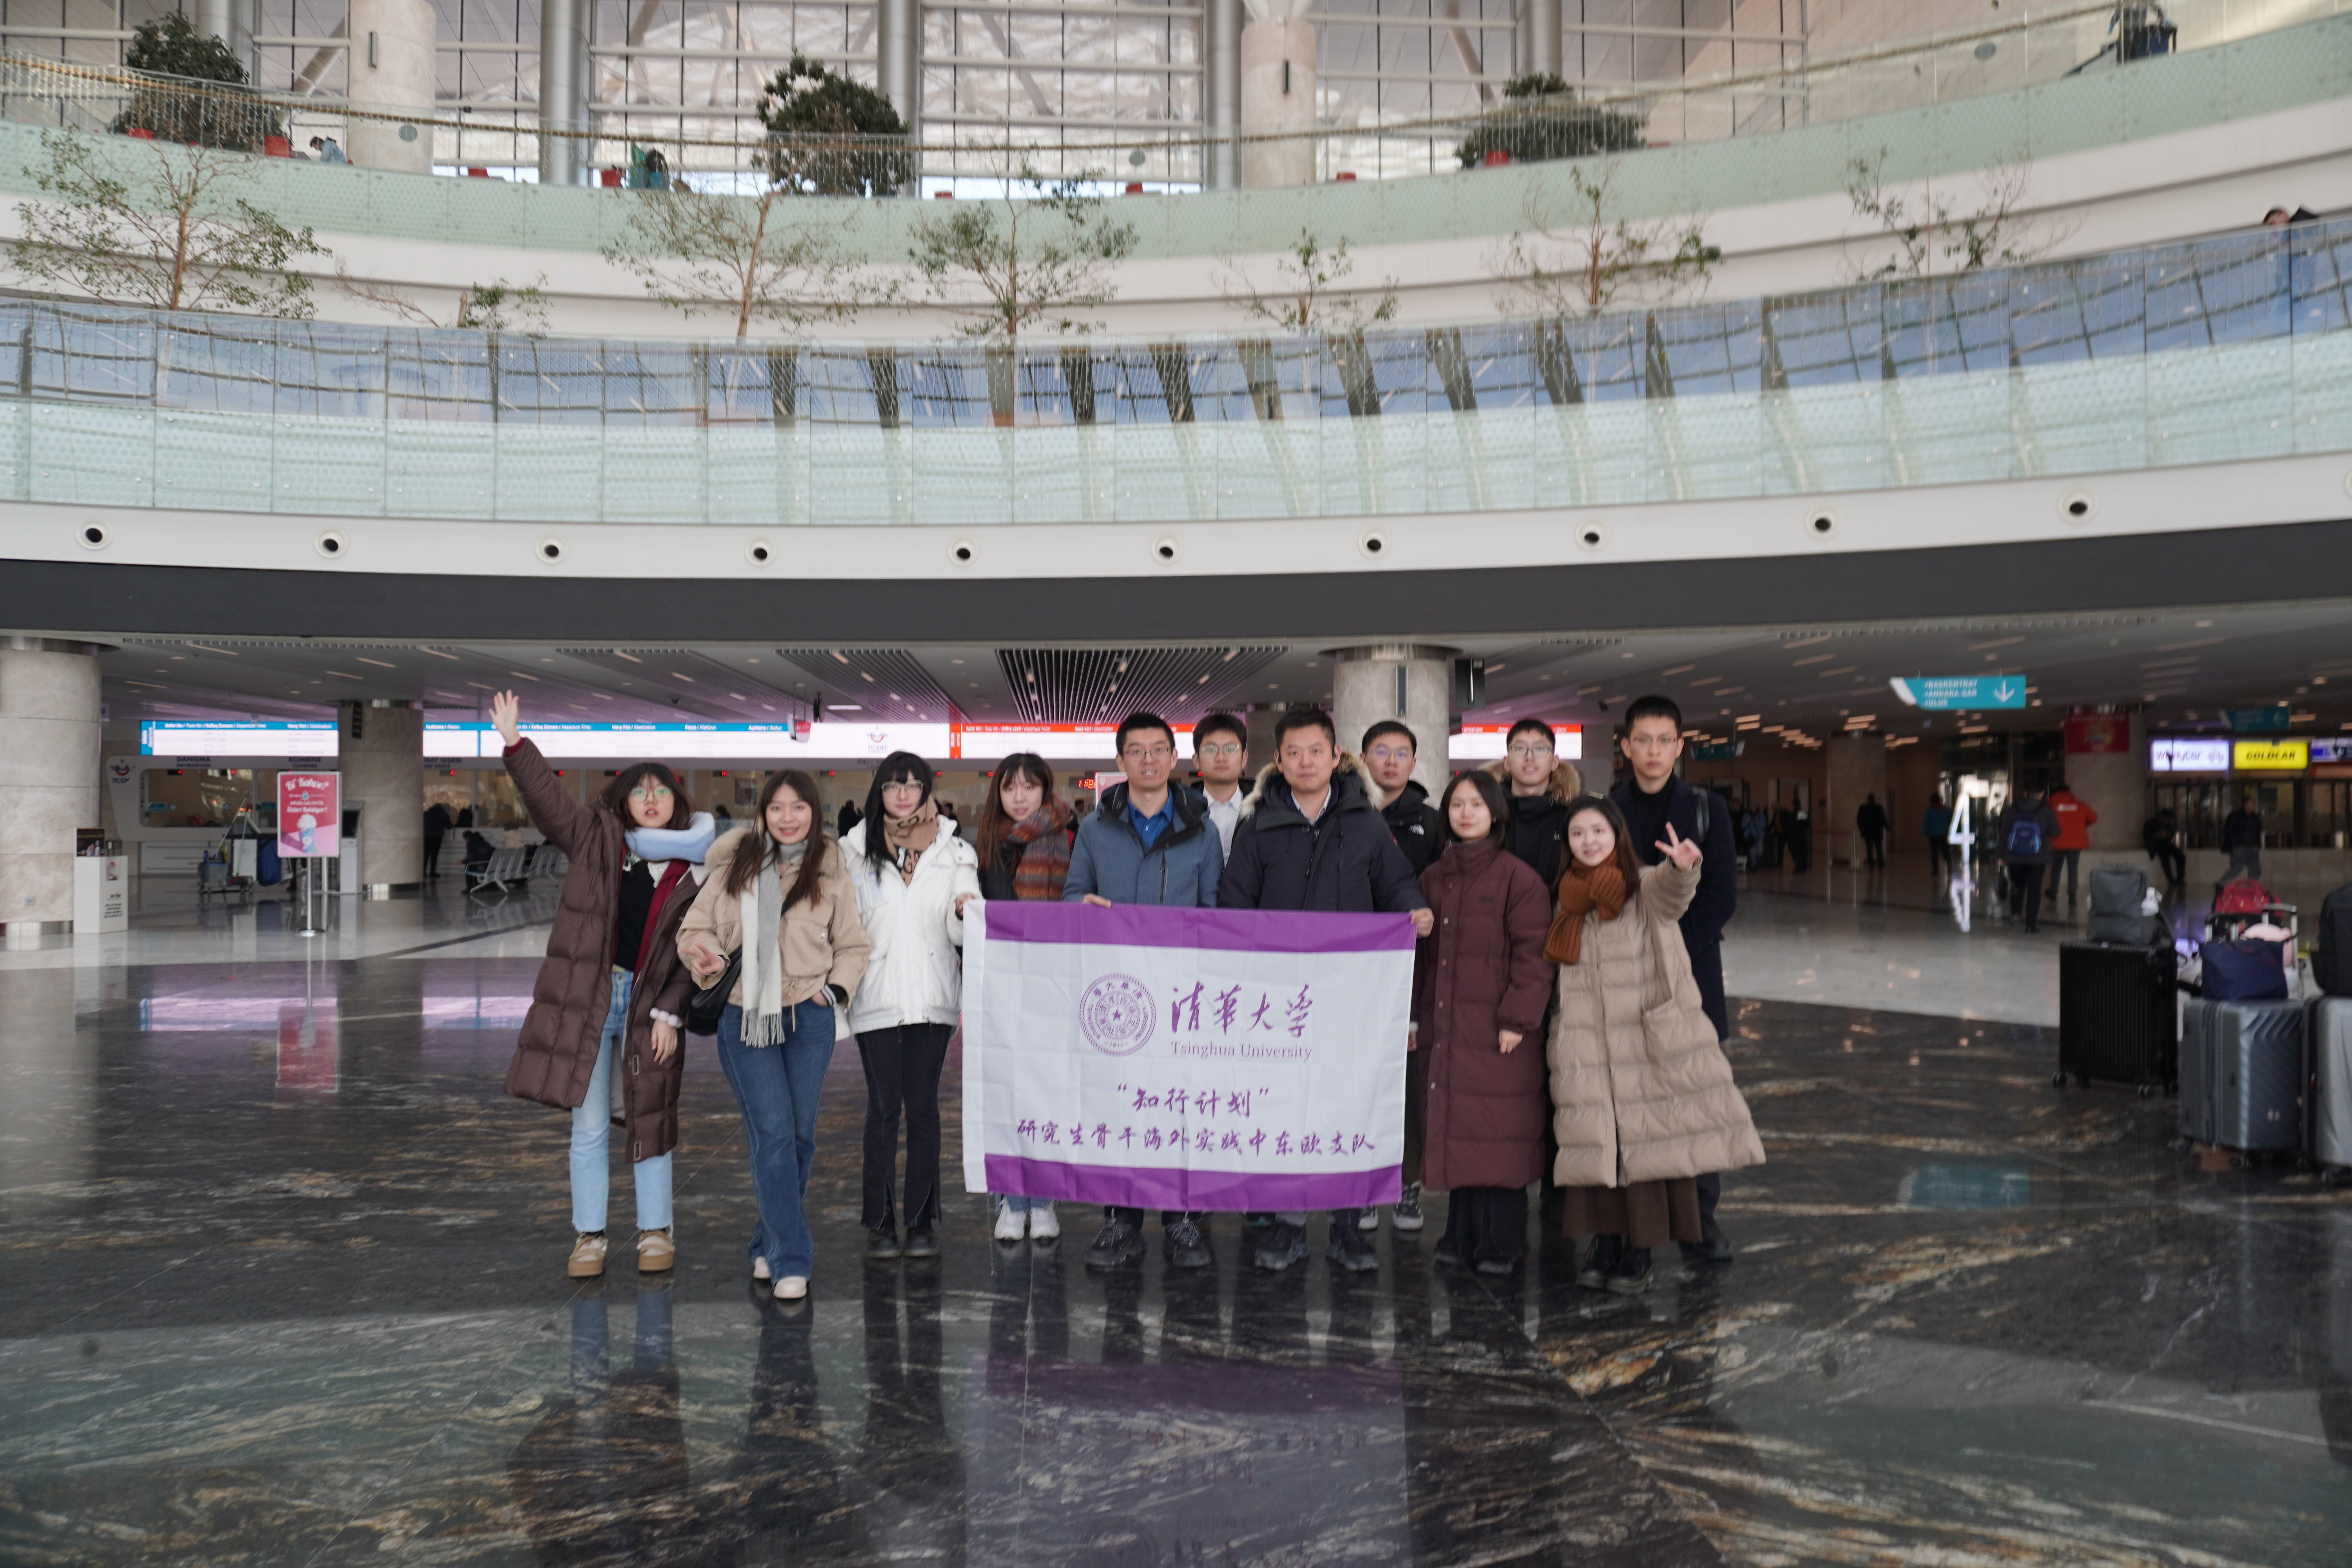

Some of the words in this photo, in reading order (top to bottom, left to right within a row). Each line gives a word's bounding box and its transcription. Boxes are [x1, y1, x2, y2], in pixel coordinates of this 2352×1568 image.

[2246, 749, 2296, 760] GOLDCAR
[298, 777, 329, 790] Kahve?
[1171, 1041, 1235, 1059] Tsinghua
[1241, 1043, 1312, 1062] University
[1017, 1118, 1375, 1158] 研究生骨干海外实践中东欧支队
